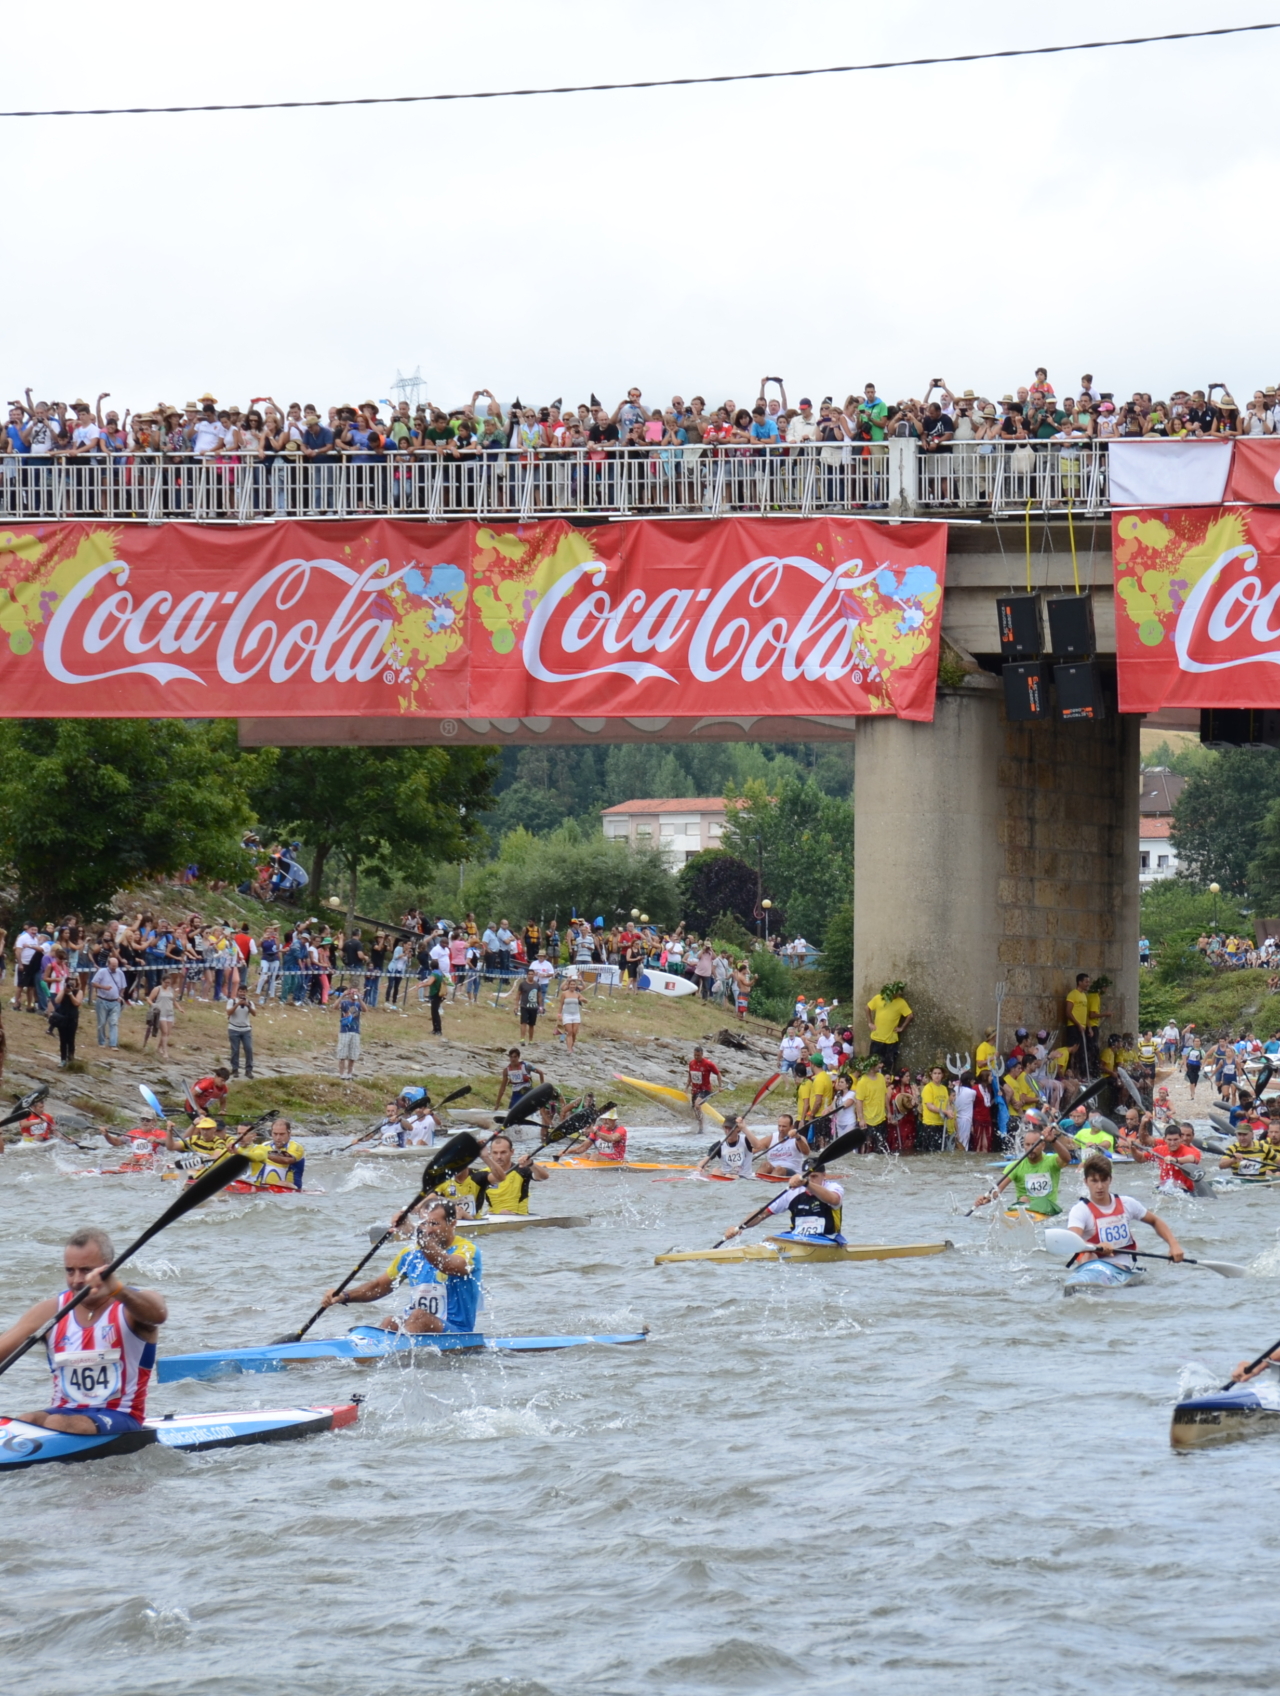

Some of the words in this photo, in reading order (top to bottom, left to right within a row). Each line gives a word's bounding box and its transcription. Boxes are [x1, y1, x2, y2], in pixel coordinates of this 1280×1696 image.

[43, 558, 418, 687] Coca-Cola
[523, 556, 892, 686] Coca-Cola
[727, 1154, 742, 1163] 423
[1030, 1181, 1048, 1192] 432
[1105, 1223, 1128, 1242] 633
[70, 1365, 110, 1391] 464
